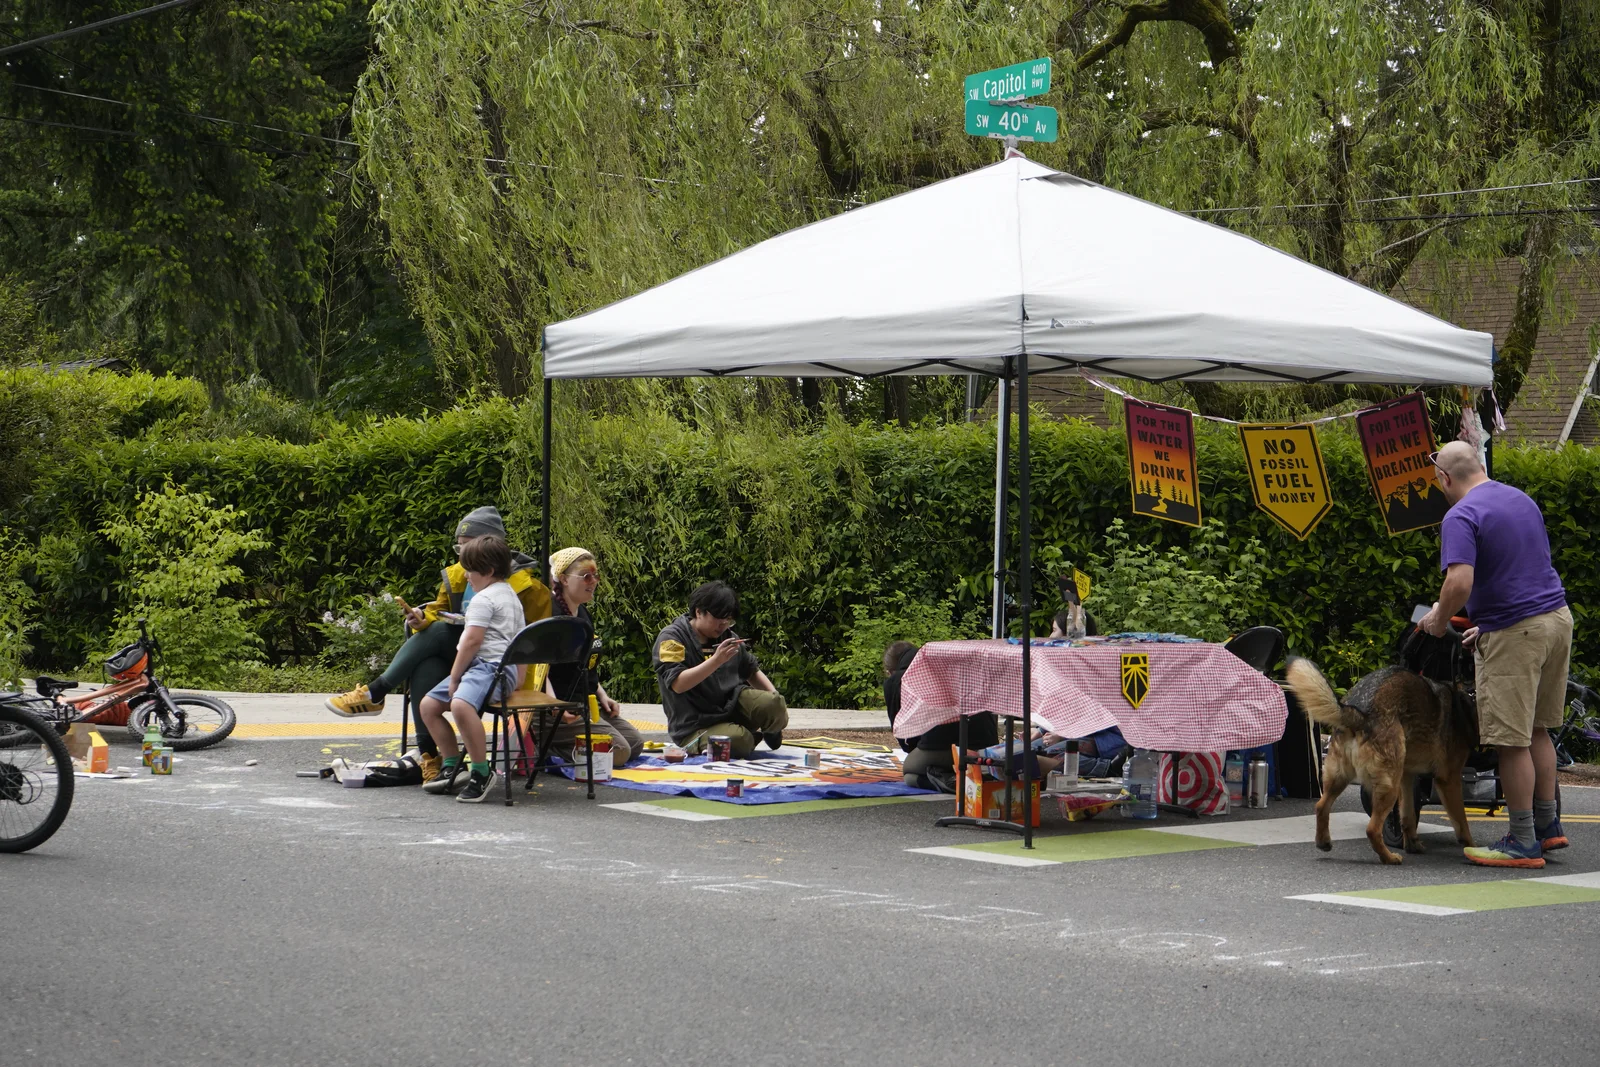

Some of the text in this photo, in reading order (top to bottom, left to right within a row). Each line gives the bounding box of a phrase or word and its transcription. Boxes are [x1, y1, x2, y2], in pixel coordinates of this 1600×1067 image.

[1032, 63, 1046, 75] 4000
[969, 70, 1043, 100] SW Capitol Hwy
[976, 111, 1046, 133] SW 40th Av
[1135, 415, 1181, 432] FOR THE
[1369, 411, 1417, 436] FOR THE
[1137, 430, 1183, 449] WATER
[1263, 439, 1296, 455] NO
[1375, 430, 1422, 458] AIR WE
[1154, 450, 1170, 462] WE
[1259, 458, 1309, 470] FOSSIL
[1140, 461, 1187, 482] DRINK
[1374, 451, 1430, 481] BREATHE
[1263, 473, 1314, 488] FUEL
[1268, 492, 1316, 503] MONEY
